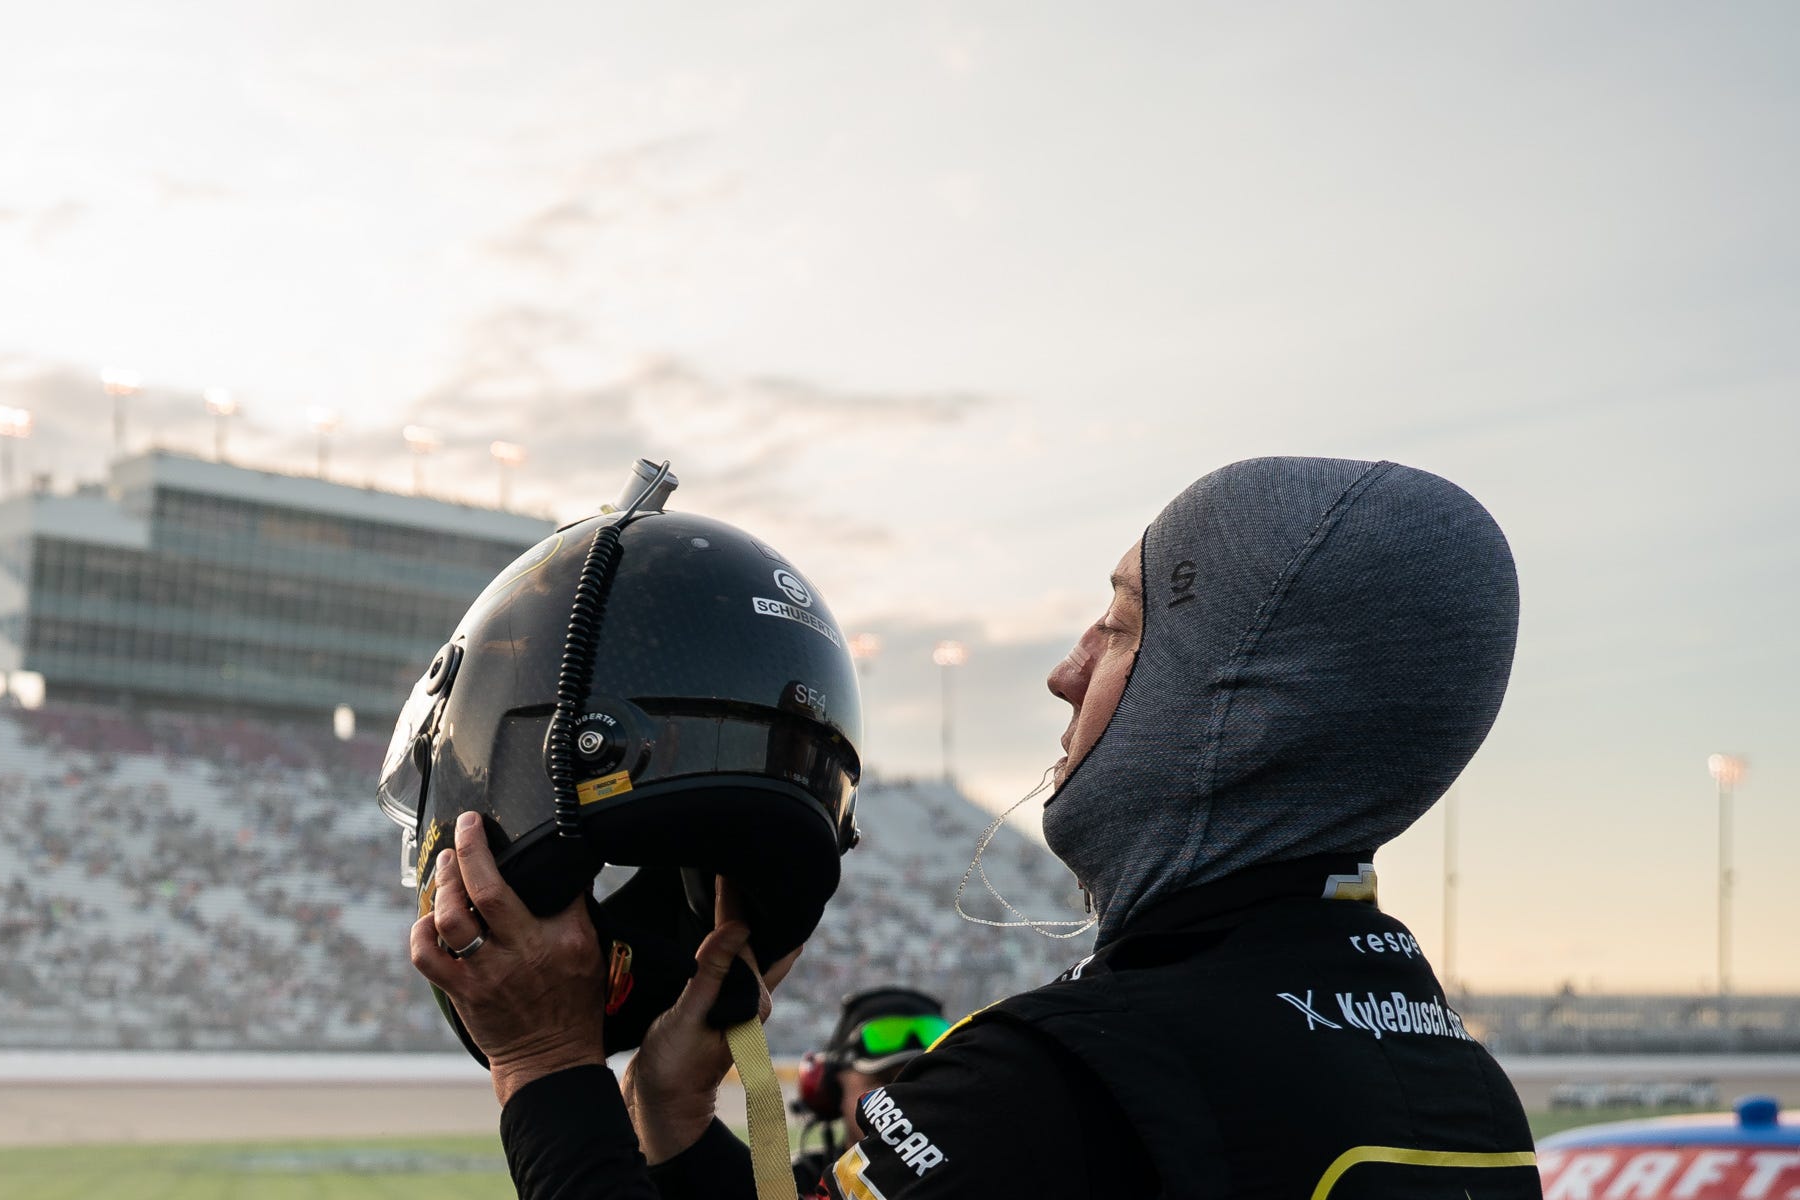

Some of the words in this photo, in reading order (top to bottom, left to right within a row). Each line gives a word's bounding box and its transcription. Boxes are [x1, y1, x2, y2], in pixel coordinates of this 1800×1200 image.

[756, 600, 841, 647] SCHUBERTH
[575, 712, 617, 727] UBERTH
[862, 1086, 944, 1177] NASCAR
